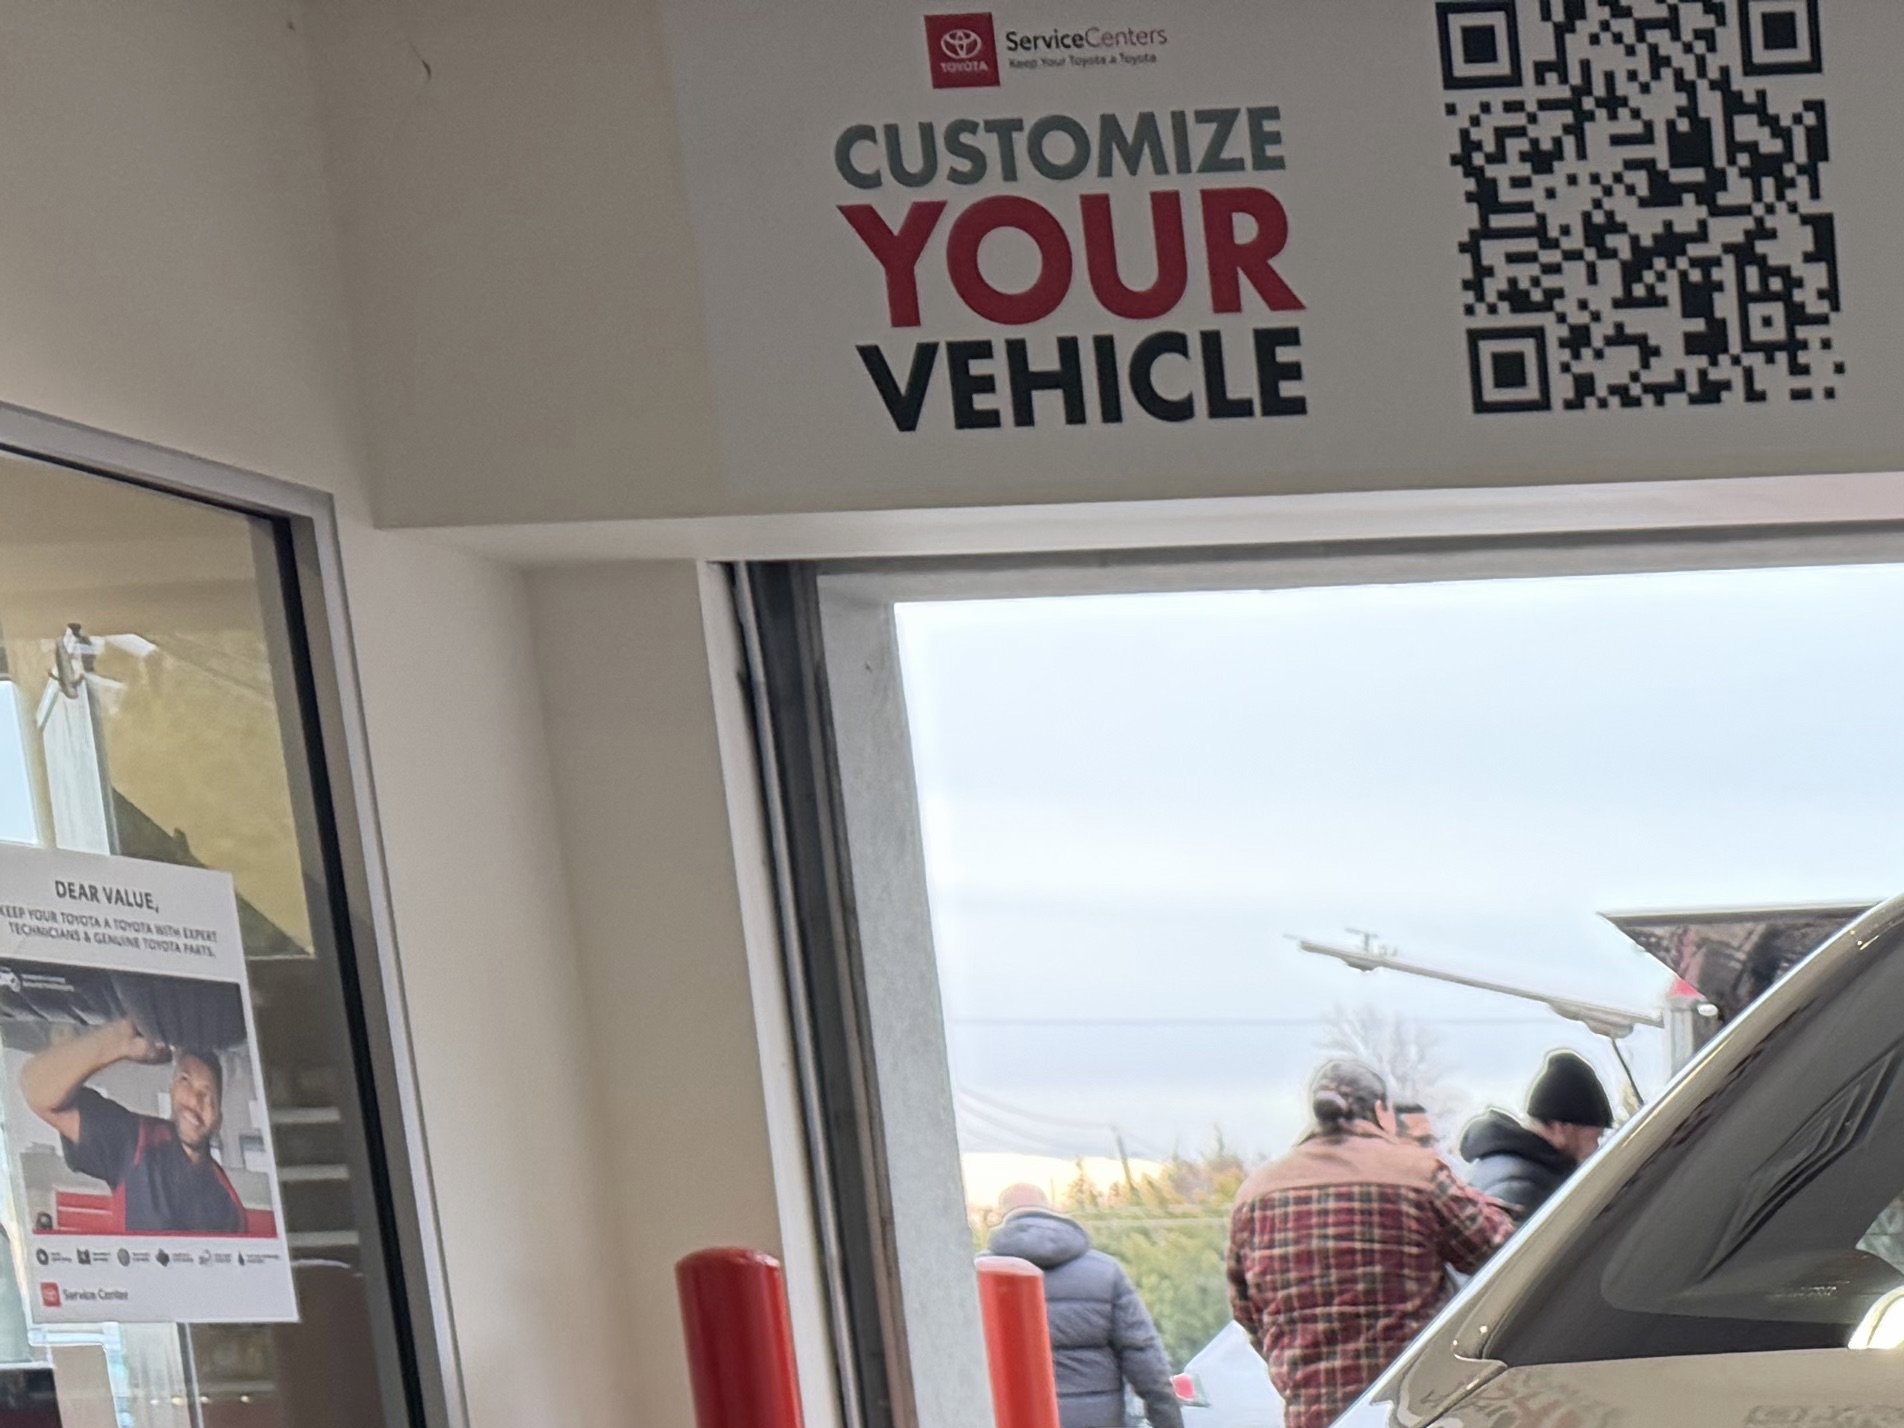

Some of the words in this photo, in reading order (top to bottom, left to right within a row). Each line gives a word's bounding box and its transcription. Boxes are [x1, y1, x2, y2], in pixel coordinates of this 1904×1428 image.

[1005, 26, 1168, 52] ServiceCenters
[940, 61, 989, 73] TOYOTA
[834, 105, 1287, 189] CUSTOMIZE
[836, 186, 1306, 328] YOUR
[855, 325, 1308, 432] VEHICLE
[55, 880, 99, 903] DEAR
[103, 886, 159, 914] VALUE,
[28, 908, 58, 924] YOUR
[61, 912, 100, 929] TOYOTA
[113, 919, 152, 934] TOYOTA
